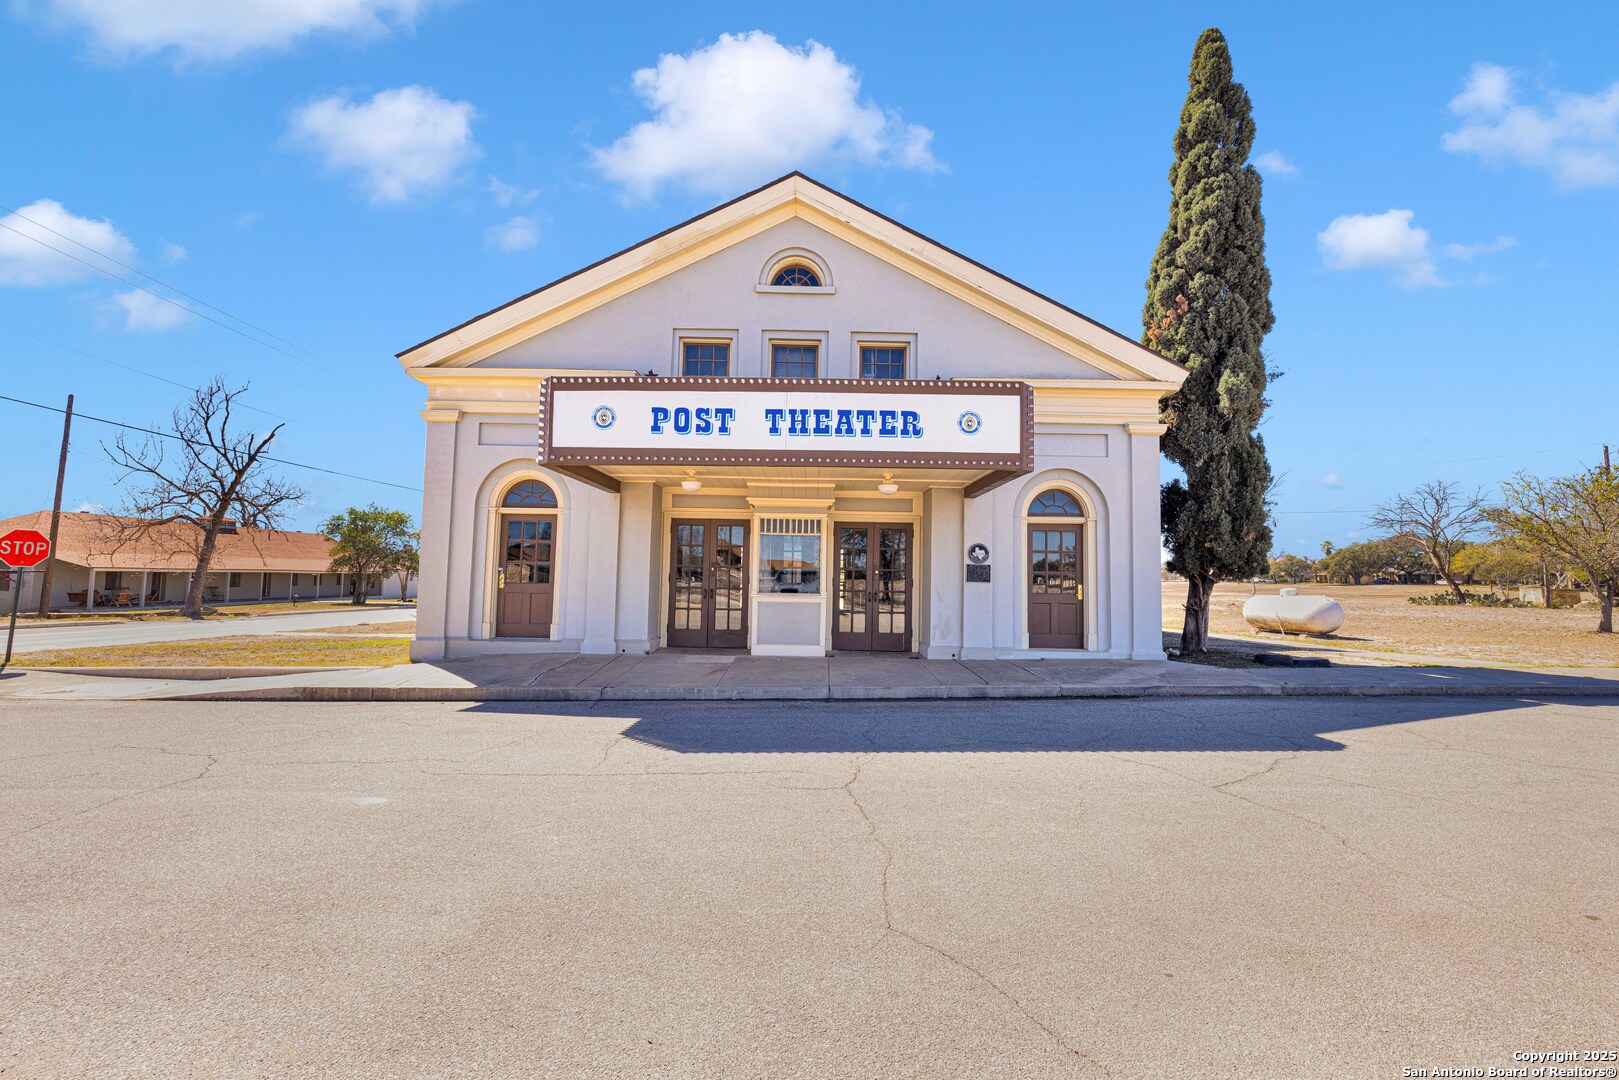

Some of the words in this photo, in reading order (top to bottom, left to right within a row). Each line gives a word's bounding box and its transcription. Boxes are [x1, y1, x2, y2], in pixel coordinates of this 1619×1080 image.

[650, 406, 737, 436] POST
[765, 408, 924, 439] THEATER
[0, 540, 47, 556] STOP
